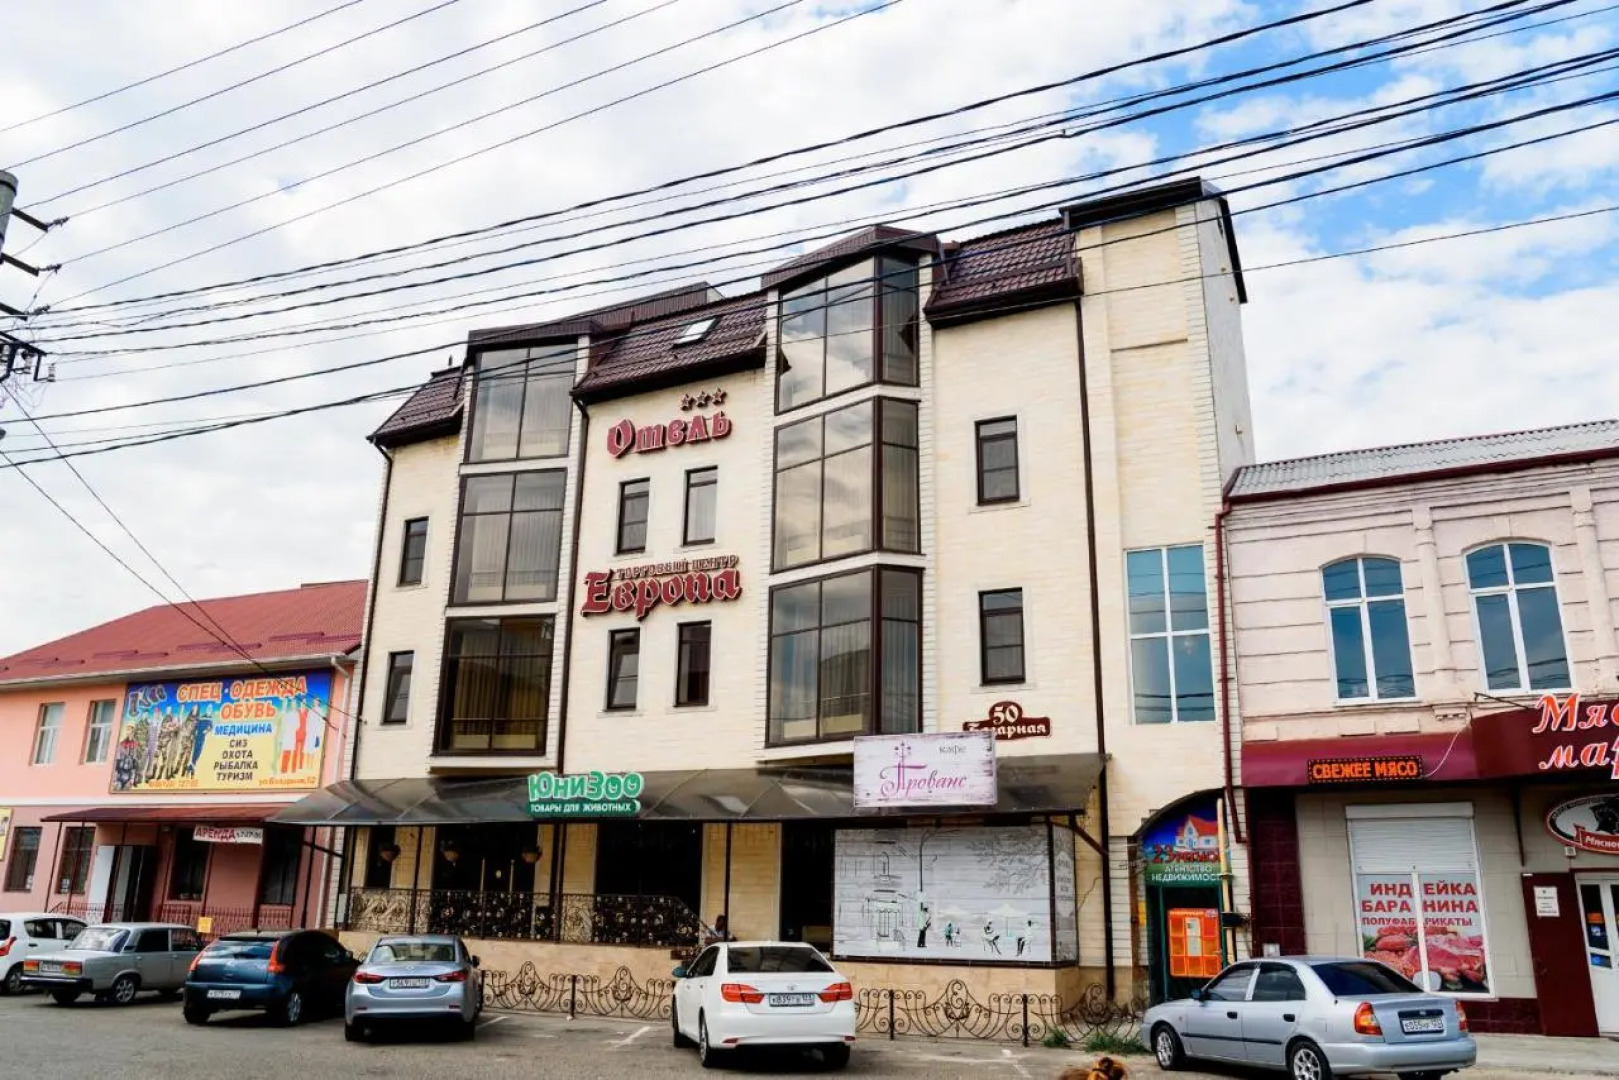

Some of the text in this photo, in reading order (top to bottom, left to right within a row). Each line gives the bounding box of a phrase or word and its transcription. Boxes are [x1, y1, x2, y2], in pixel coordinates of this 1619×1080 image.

[607, 412, 732, 459] Отель
[616, 554, 739, 579] ТОРГОВЫЙ ЦЕНТР
[582, 568, 743, 618] Европа
[229, 676, 307, 700] ОДЕЖДА
[220, 703, 276, 721] ОБУВЬ
[992, 705, 1019, 725] 50
[214, 723, 272, 736] МЕДИЦИНА
[229, 739, 247, 749] СИЗ
[939, 745, 967, 756] кафе
[222, 750, 253, 760] ОХОТА
[213, 761, 258, 771] РЫБАЛКА
[1313, 761, 1418, 779] СВЕЖЕЕ МЯСО
[216, 772, 253, 781] ТУРИЗМ
[879, 762, 967, 798] Прованс
[530, 802, 632, 813] ТОВАРЫ ДЛЯ ЖИВОТНЫХ
[195, 826, 235, 840] АРЕНДА
[1152, 845, 1175, 864] 23
